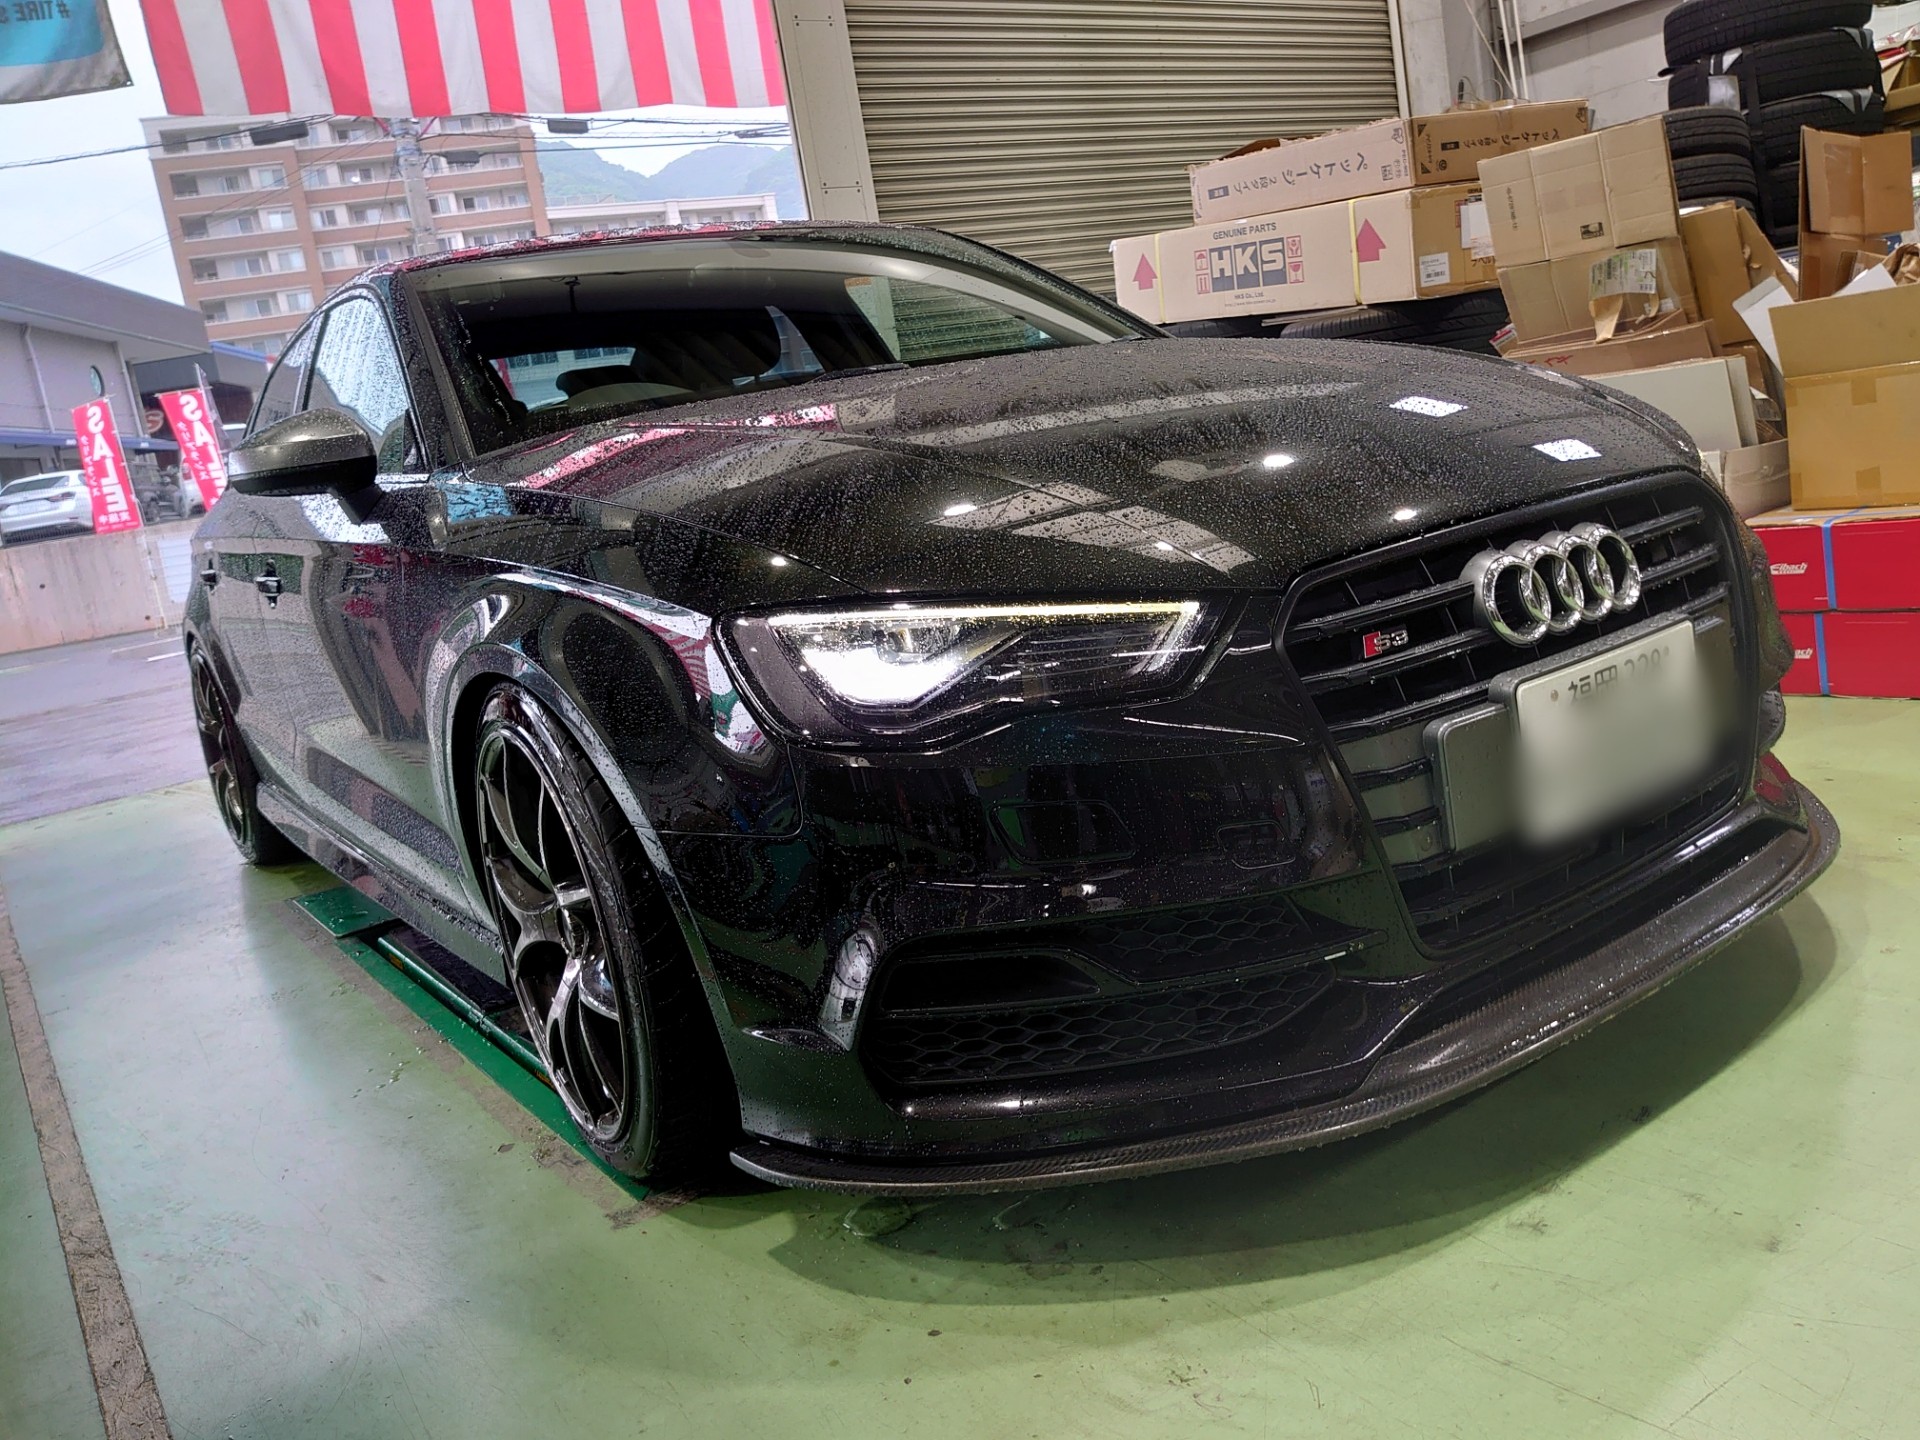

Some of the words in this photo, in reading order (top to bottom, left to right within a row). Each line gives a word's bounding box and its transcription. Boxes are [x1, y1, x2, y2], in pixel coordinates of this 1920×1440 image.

[1213, 227, 1247, 240] GENUINE
[1249, 222, 1277, 234] PARTS
[1209, 239, 1286, 282] HKS
[1373, 630, 1409, 652] S3
